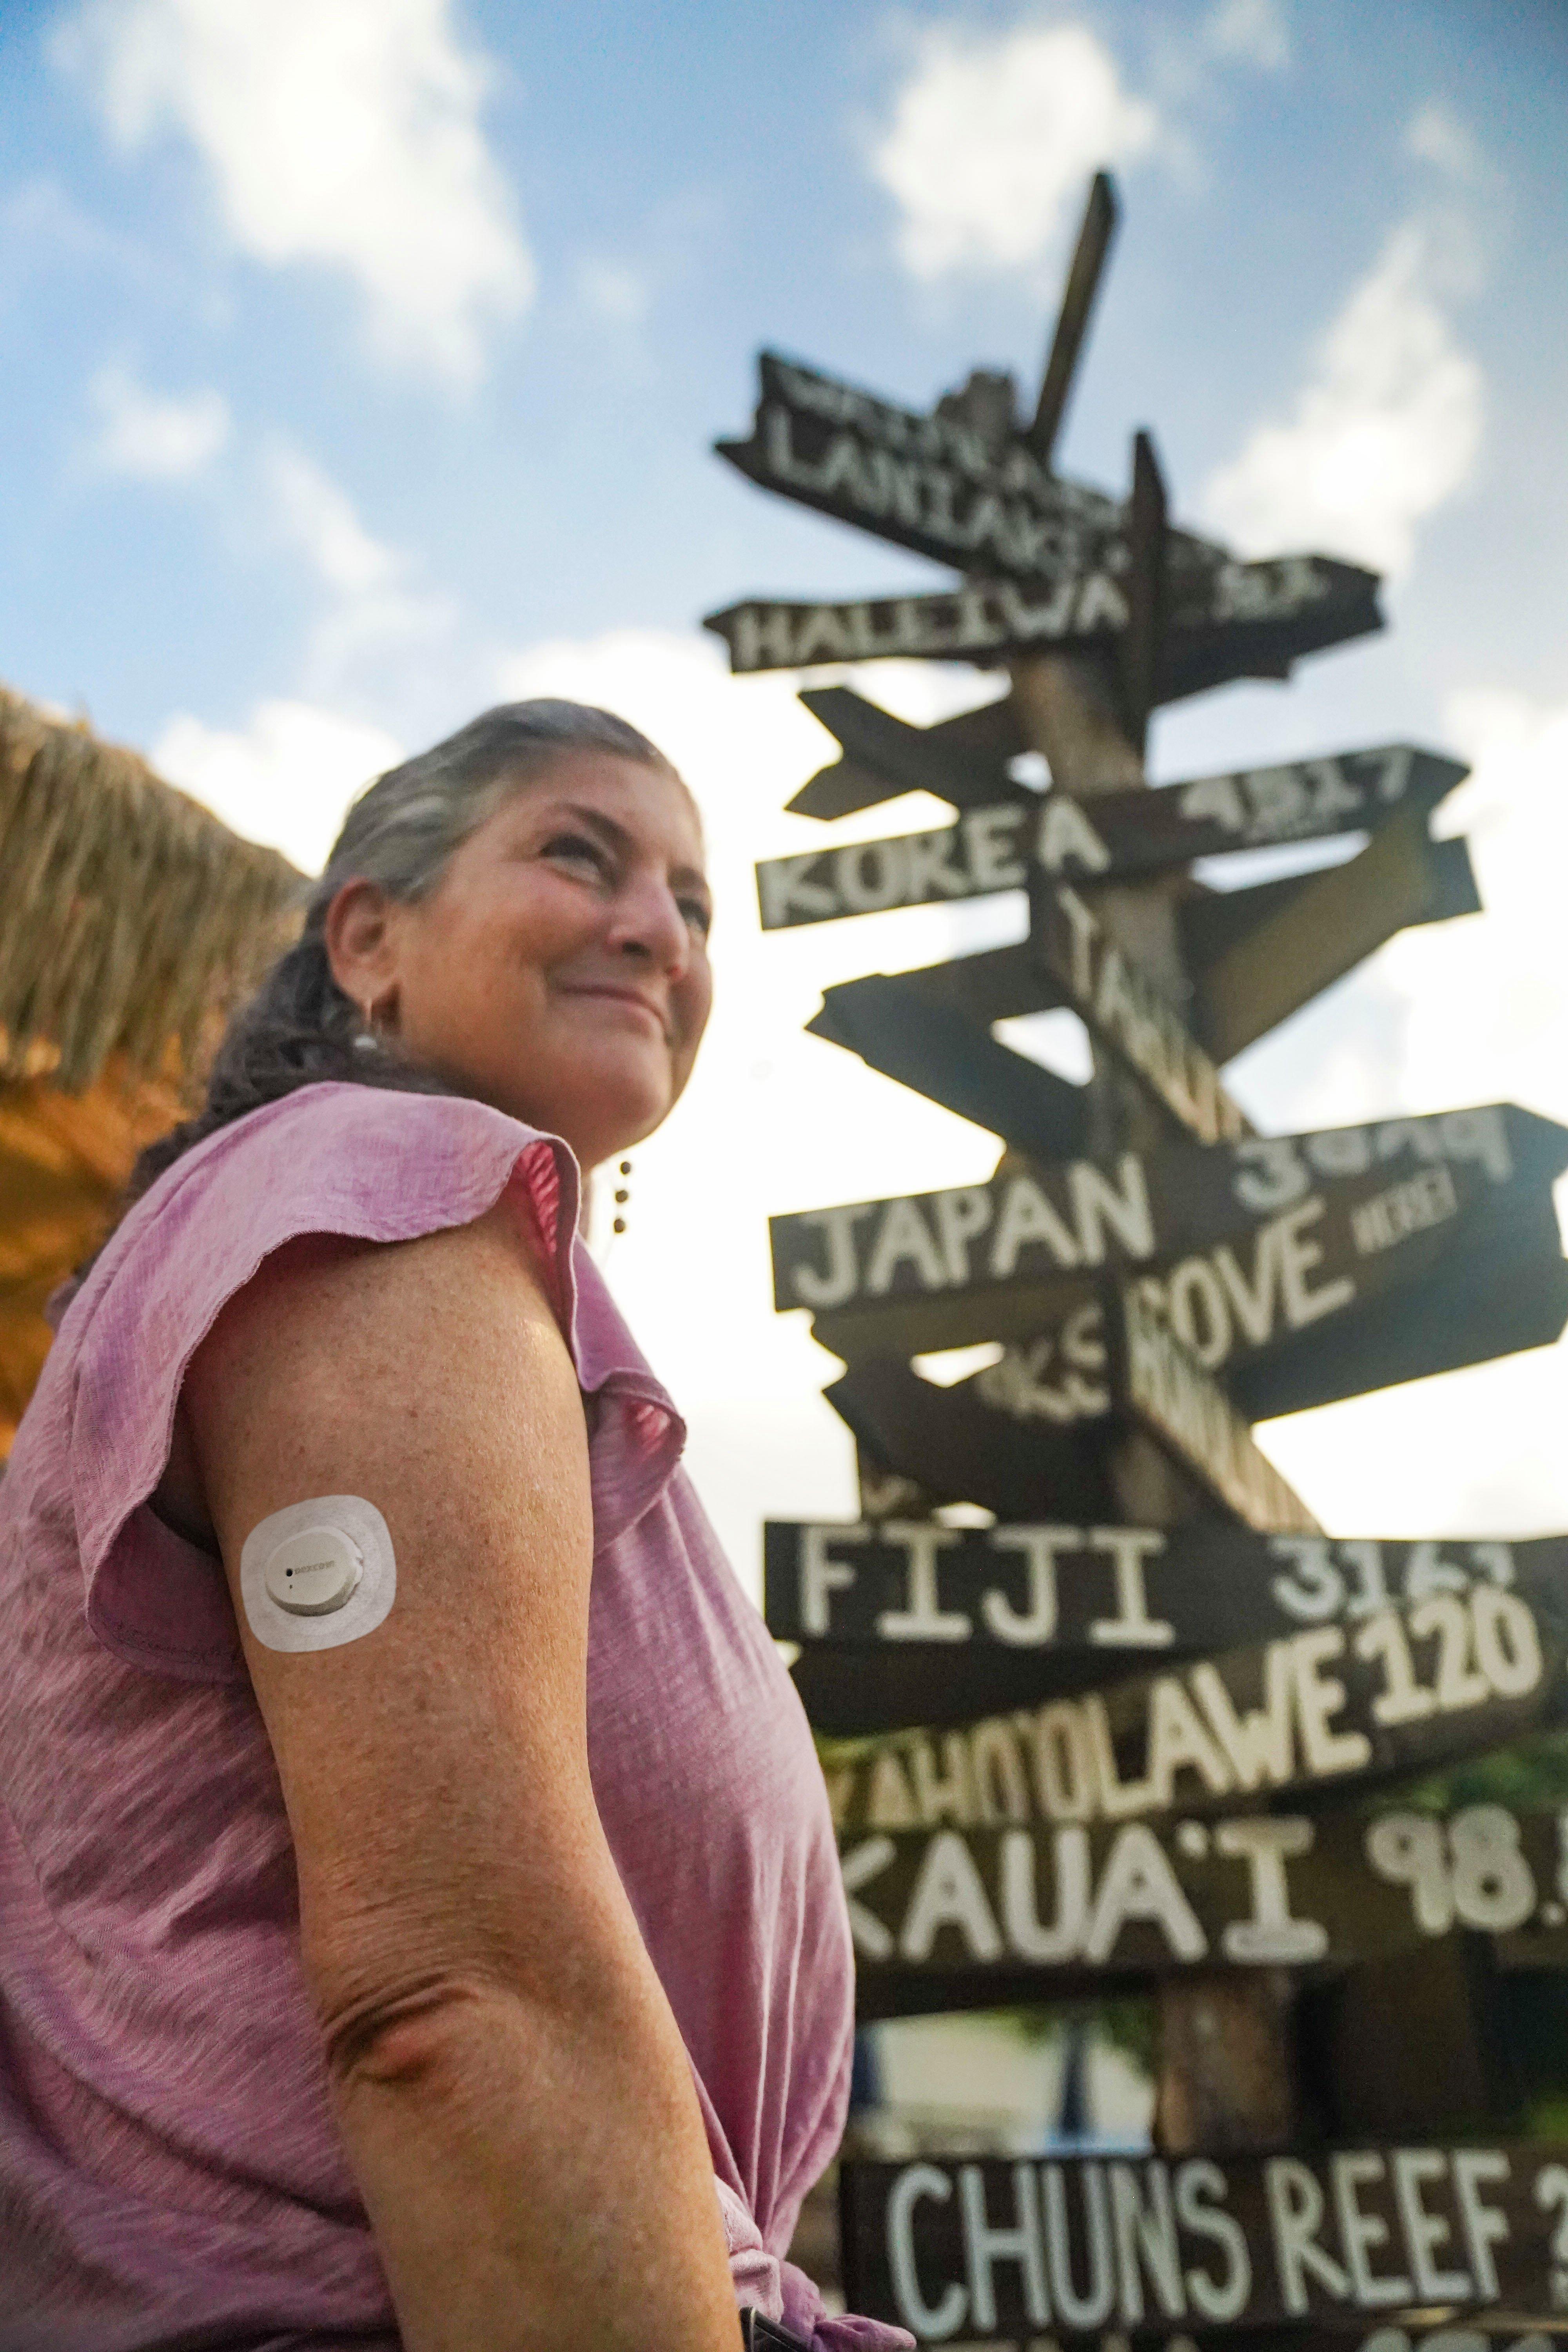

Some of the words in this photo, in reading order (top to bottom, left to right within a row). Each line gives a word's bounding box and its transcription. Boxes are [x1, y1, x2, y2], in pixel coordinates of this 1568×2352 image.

[764, 793, 1111, 924] KOREA
[791, 1149, 1156, 1308] JAPAN
[799, 1523, 1174, 1648] FIJI
[1352, 1586, 1544, 1725] 120
[1364, 1802, 1568, 1938] 98.
[886, 2160, 1253, 2340] CHUNS
[1265, 2147, 1512, 2319] REEF
